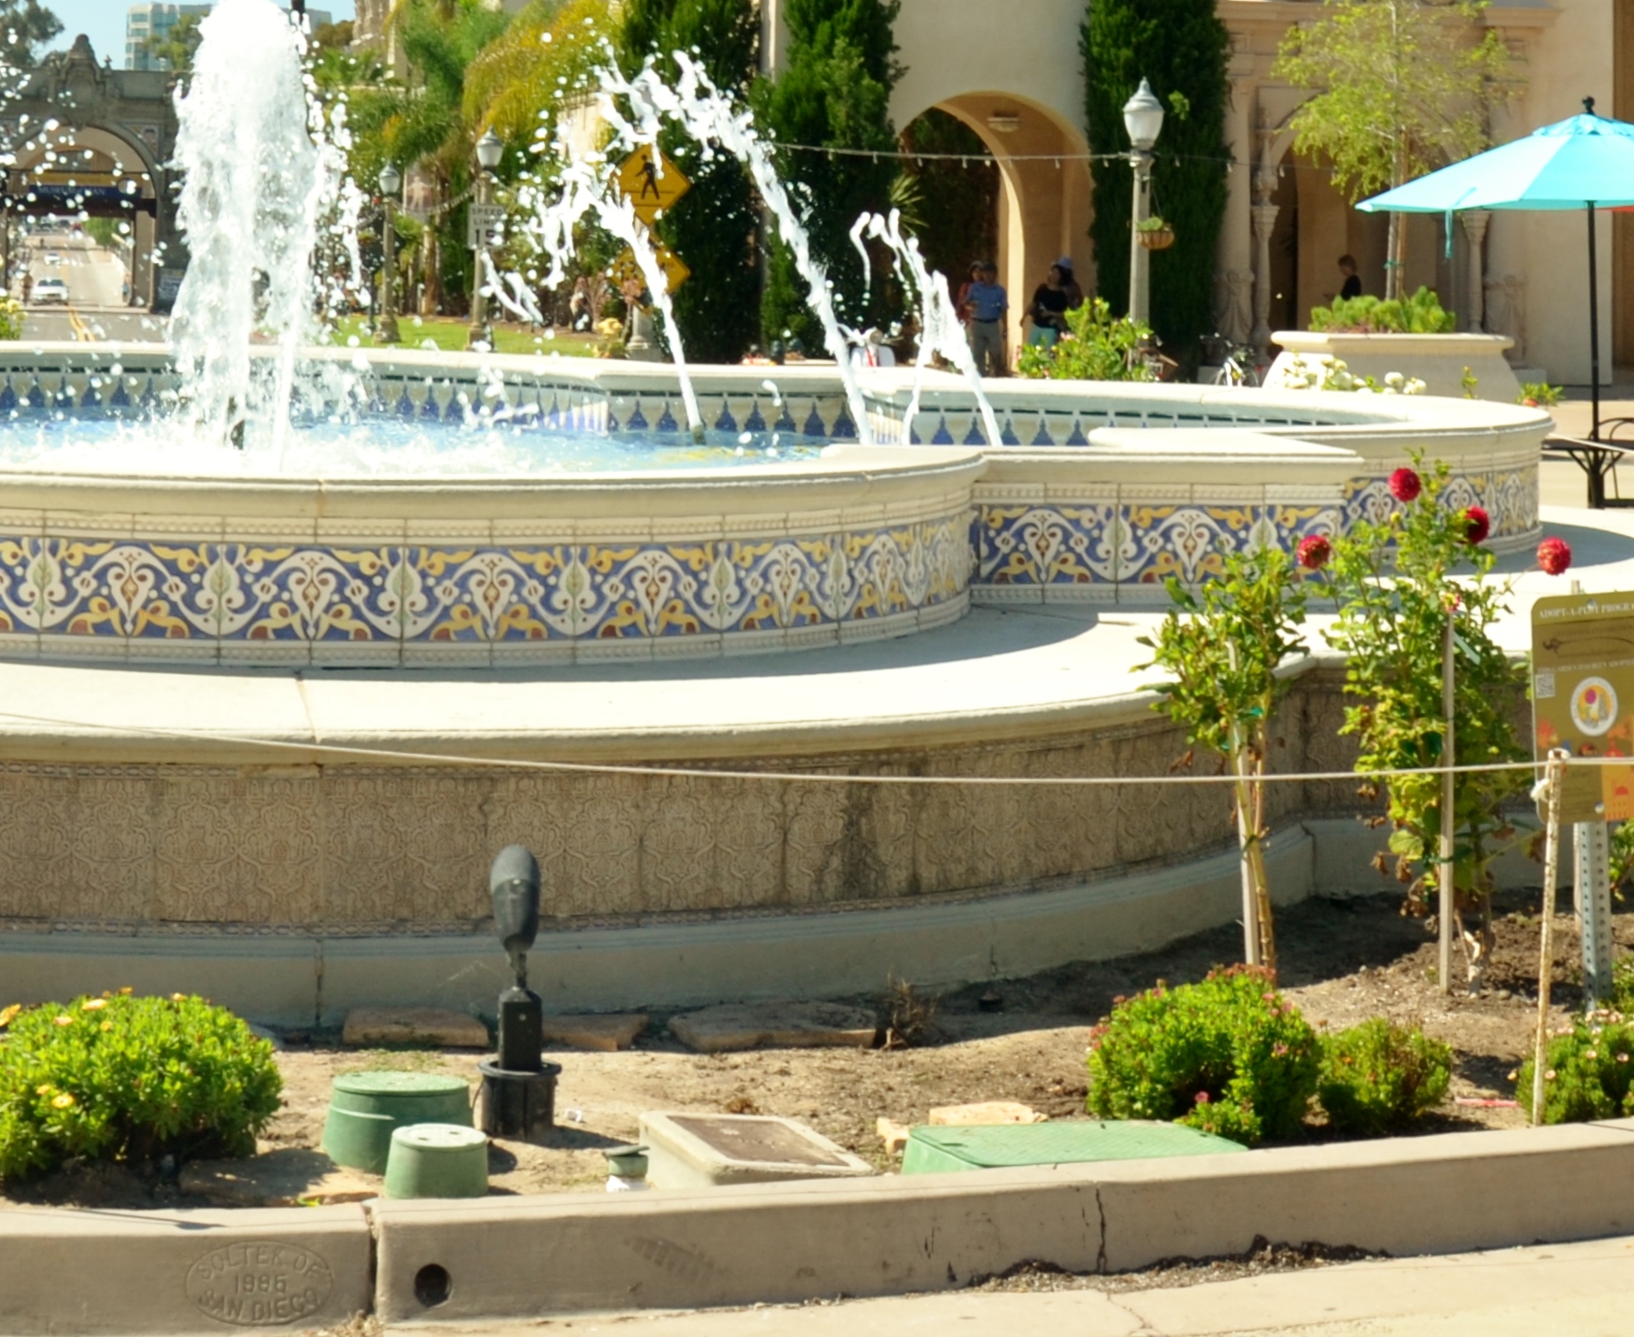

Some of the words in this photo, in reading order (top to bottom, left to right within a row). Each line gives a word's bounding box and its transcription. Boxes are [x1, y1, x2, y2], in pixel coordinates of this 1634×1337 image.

[471, 207, 503, 215] SPEED
[198, 1289, 244, 1320] SAN
[251, 1288, 321, 1322] DIEGO
